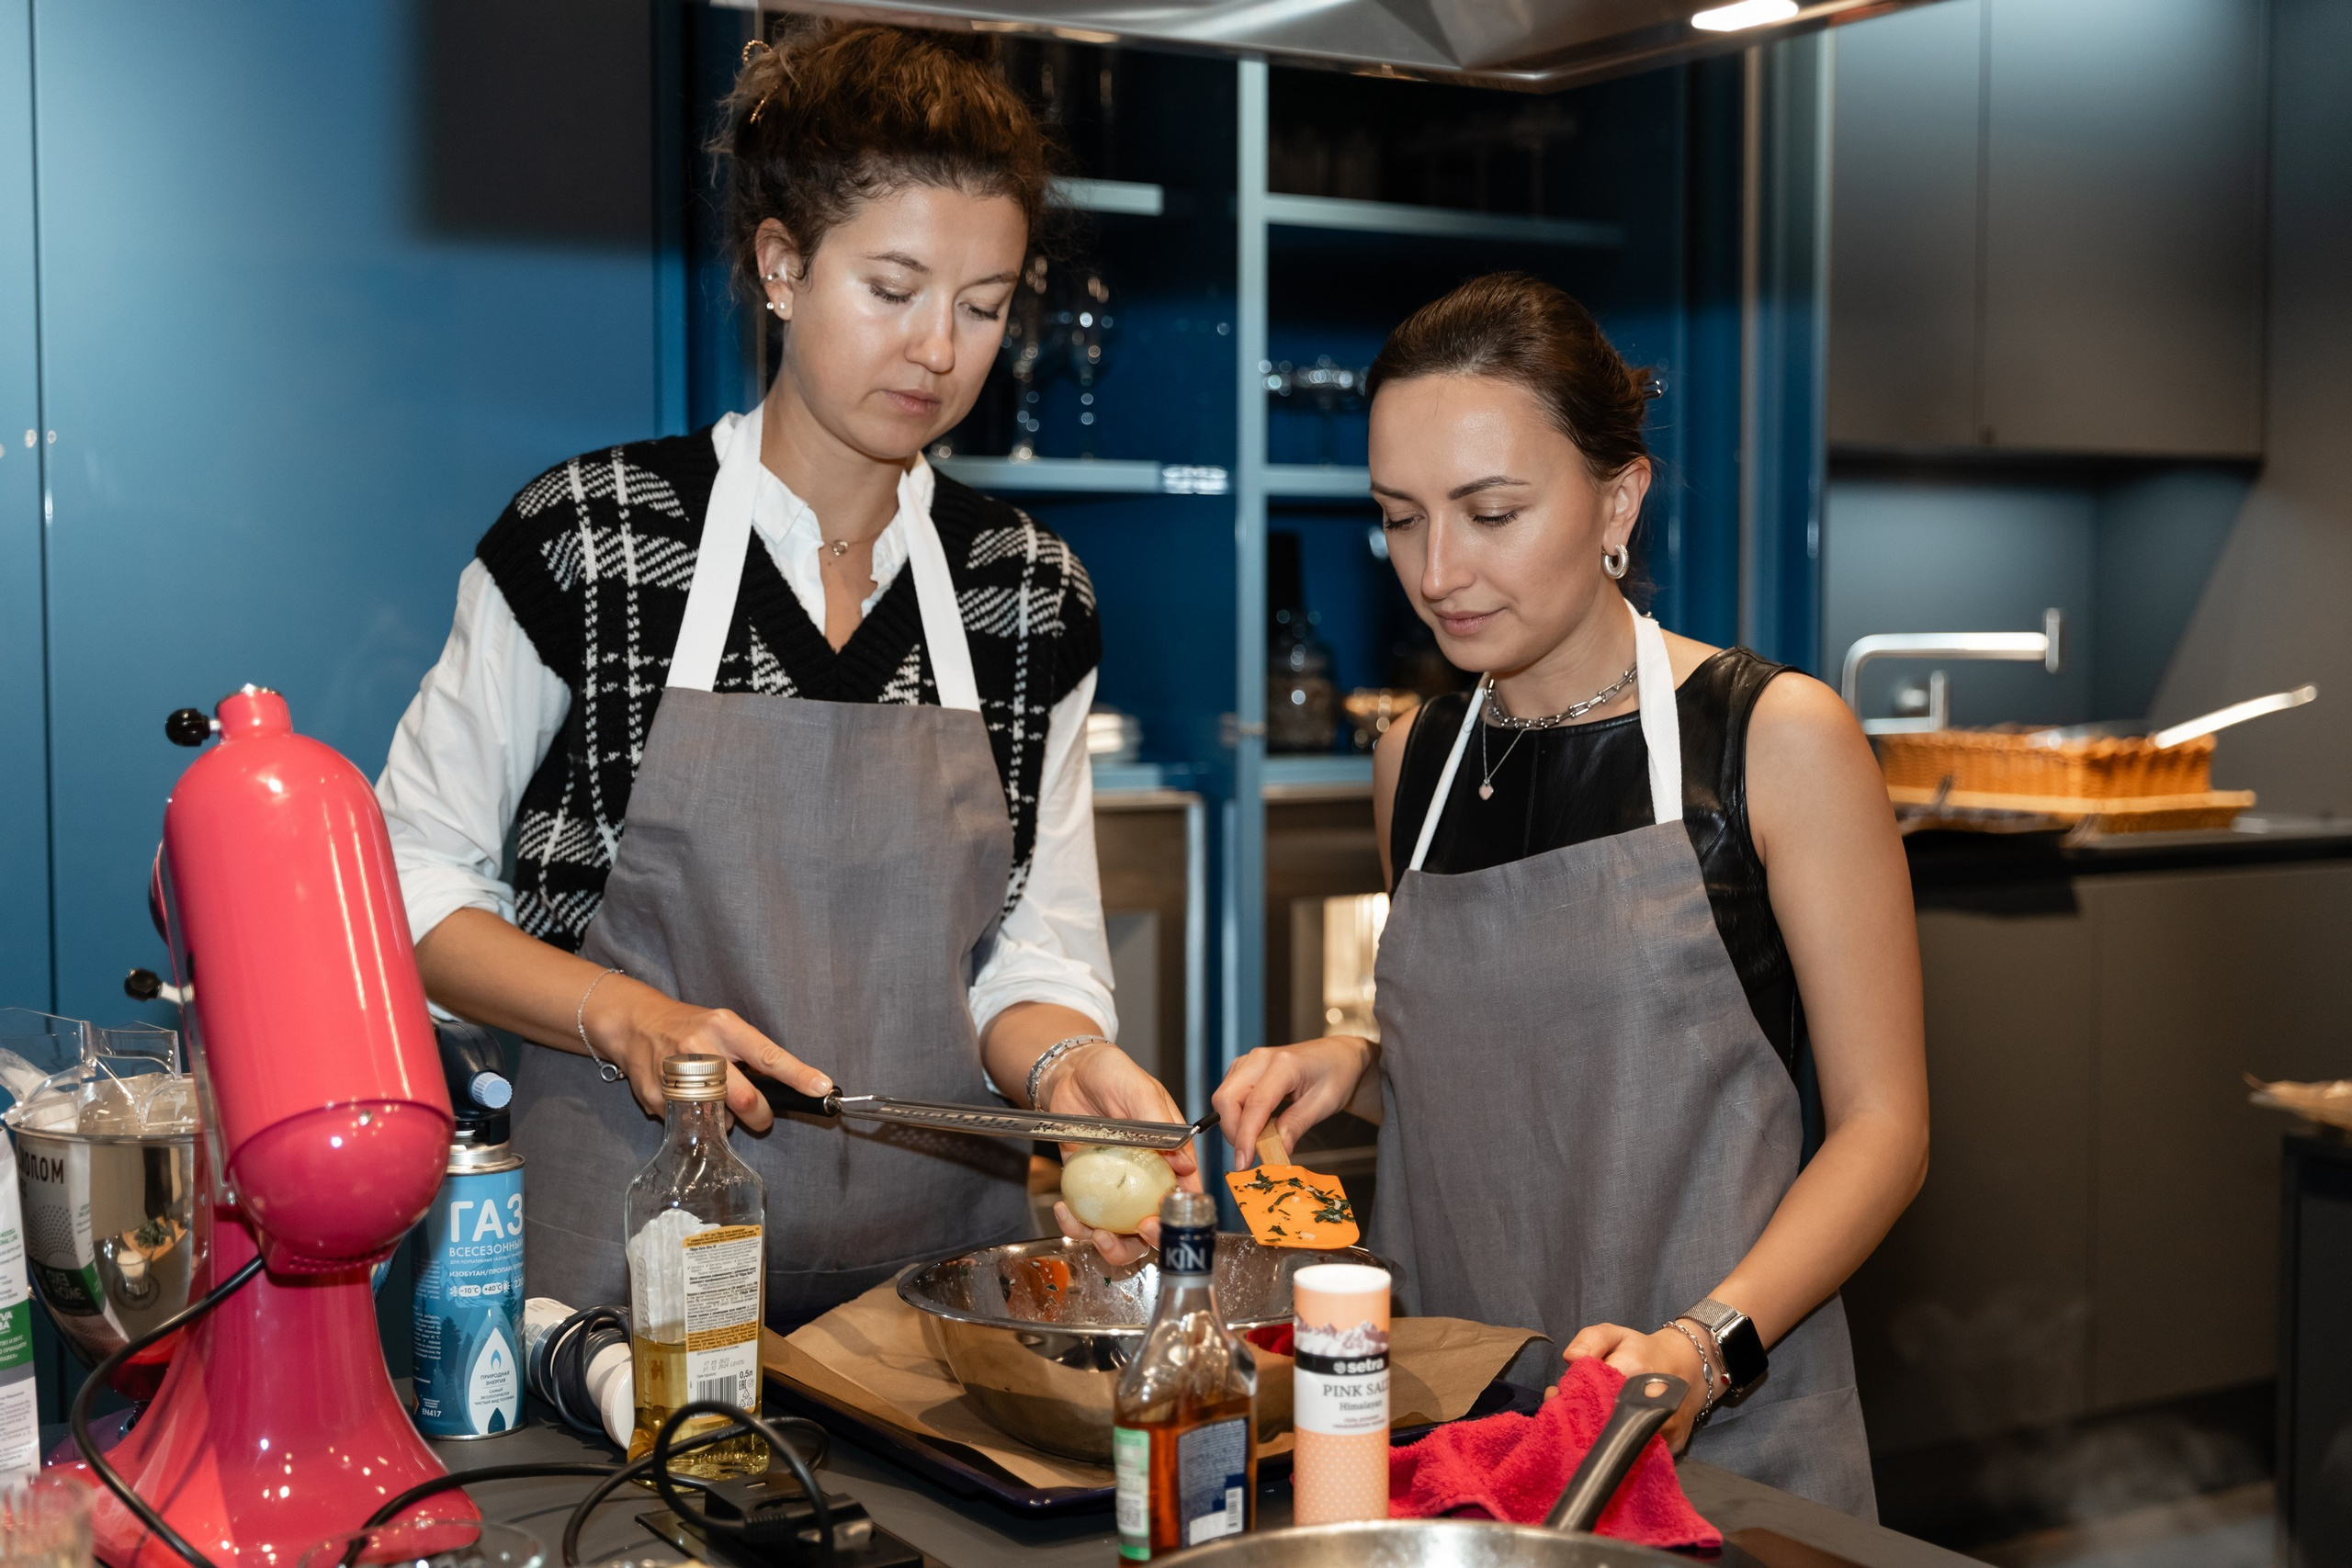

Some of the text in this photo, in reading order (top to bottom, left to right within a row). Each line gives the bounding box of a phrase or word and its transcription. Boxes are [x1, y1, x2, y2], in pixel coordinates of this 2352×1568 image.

[450, 1192, 524, 1243] ГАЗ
[1347, 1359, 1384, 1374] setra
[481, 1370, 510, 1381] ПРИРОДНАЯ
[739, 1369, 753, 1379] 0,5л
[485, 1378, 506, 1386] ЭНЕРГИЯ
[1323, 1384, 1363, 1397] PINK
[1340, 1400, 1383, 1411] Himalayan
[423, 1407, 442, 1418] EN417
